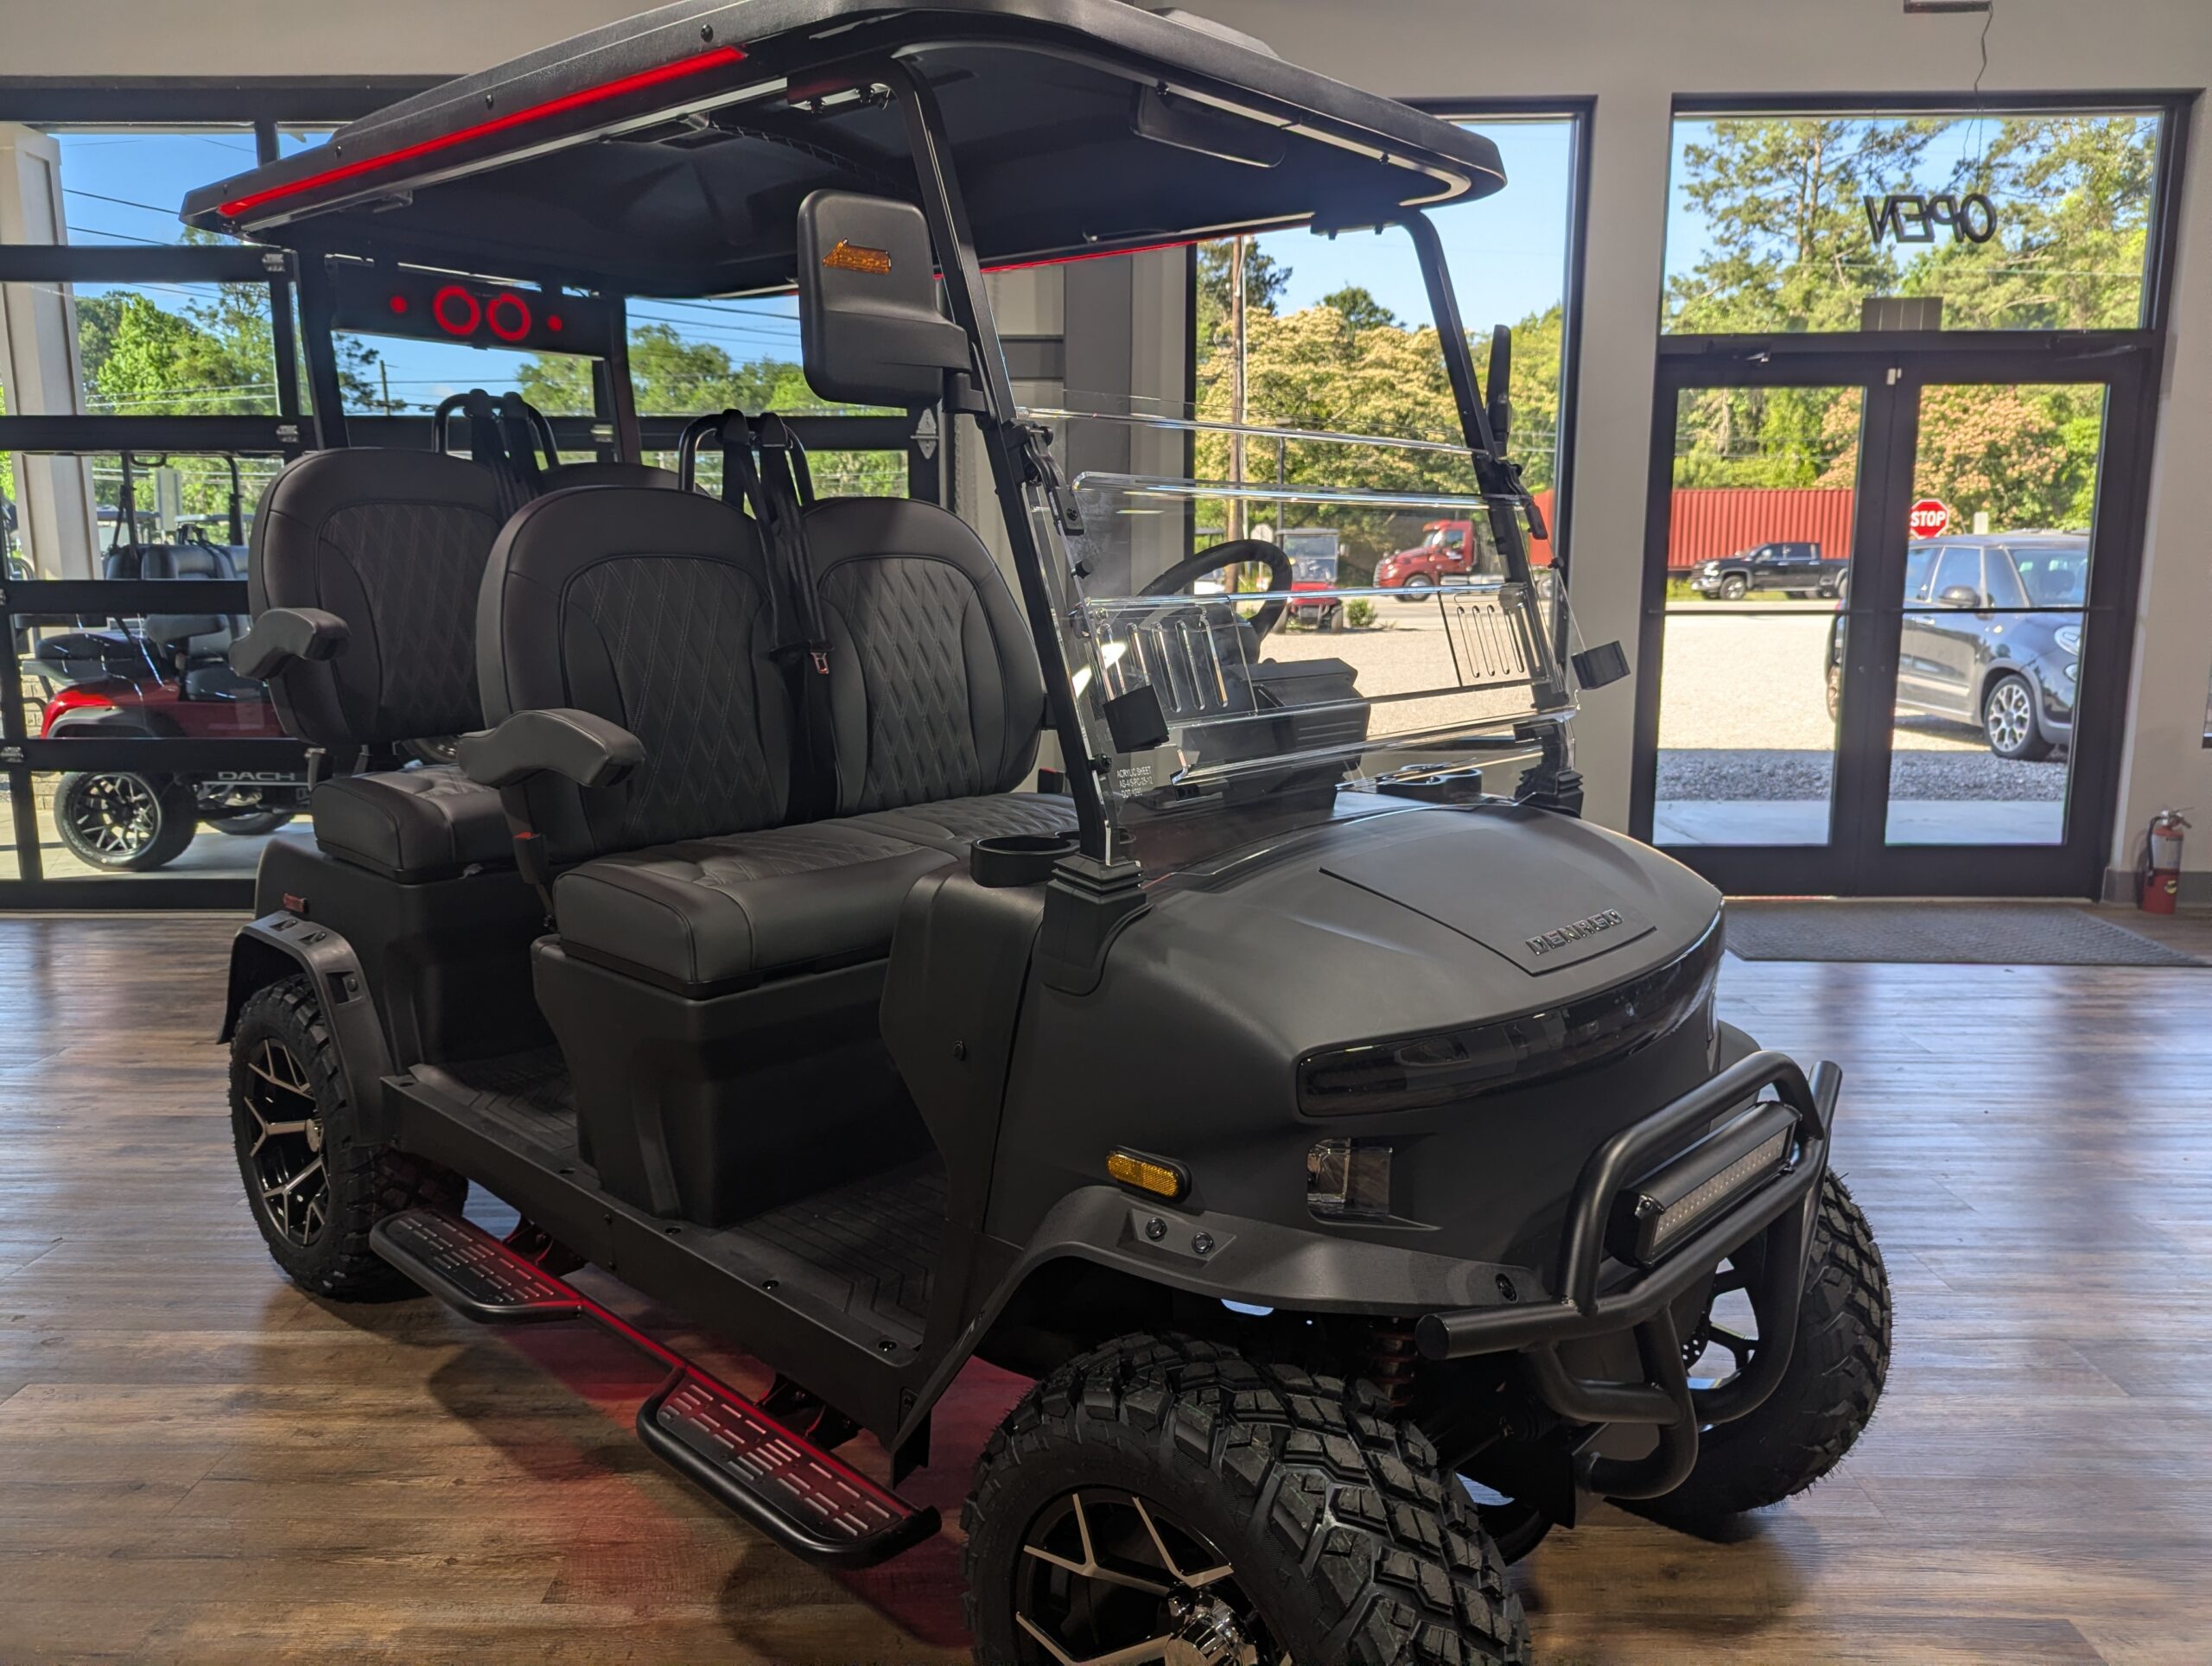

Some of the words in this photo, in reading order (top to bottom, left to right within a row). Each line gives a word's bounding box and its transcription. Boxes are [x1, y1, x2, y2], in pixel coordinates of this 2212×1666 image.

[1910, 510, 1947, 527] STOP
[217, 771, 296, 781] DACH
[1525, 908, 1624, 955] DENAGO
